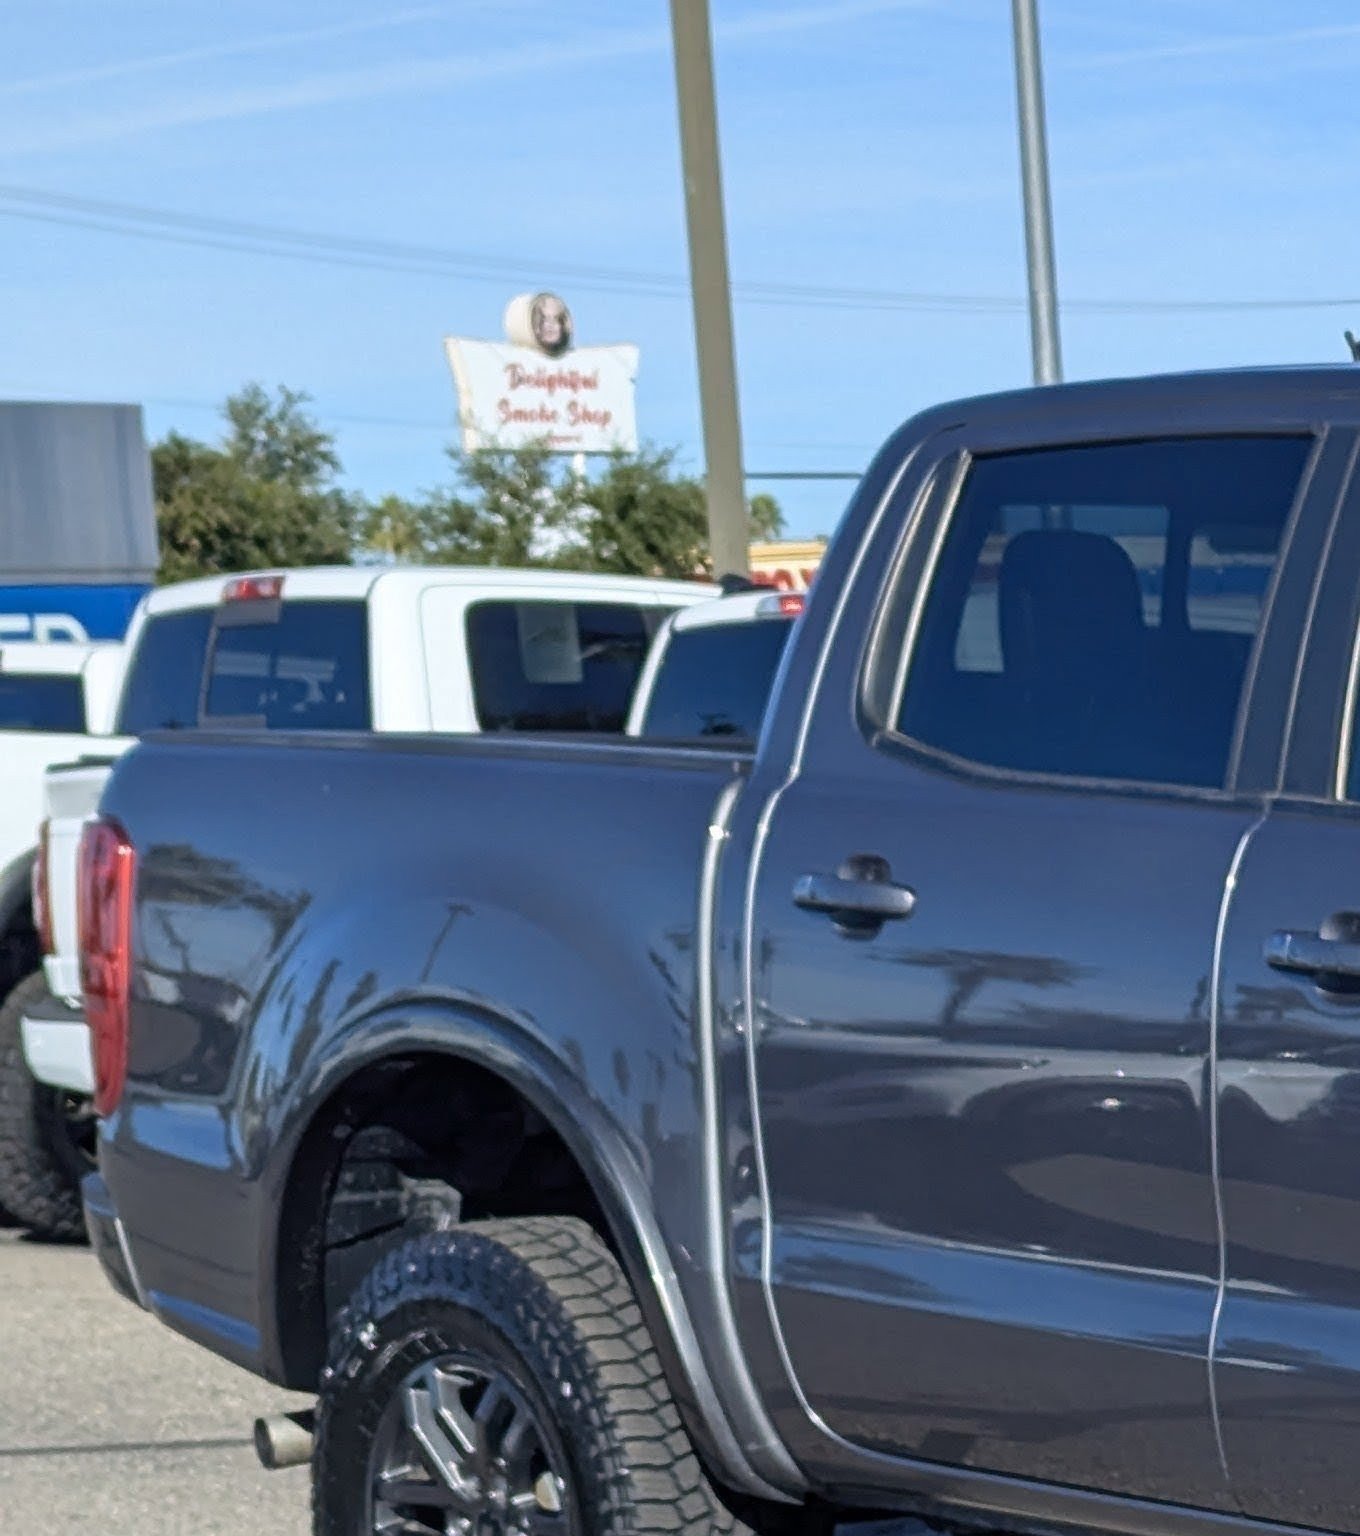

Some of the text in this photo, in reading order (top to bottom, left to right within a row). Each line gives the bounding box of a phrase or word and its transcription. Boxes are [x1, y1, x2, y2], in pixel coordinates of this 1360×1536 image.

[506, 364, 598, 394] Delightful
[498, 398, 613, 430] Smoke Shop
